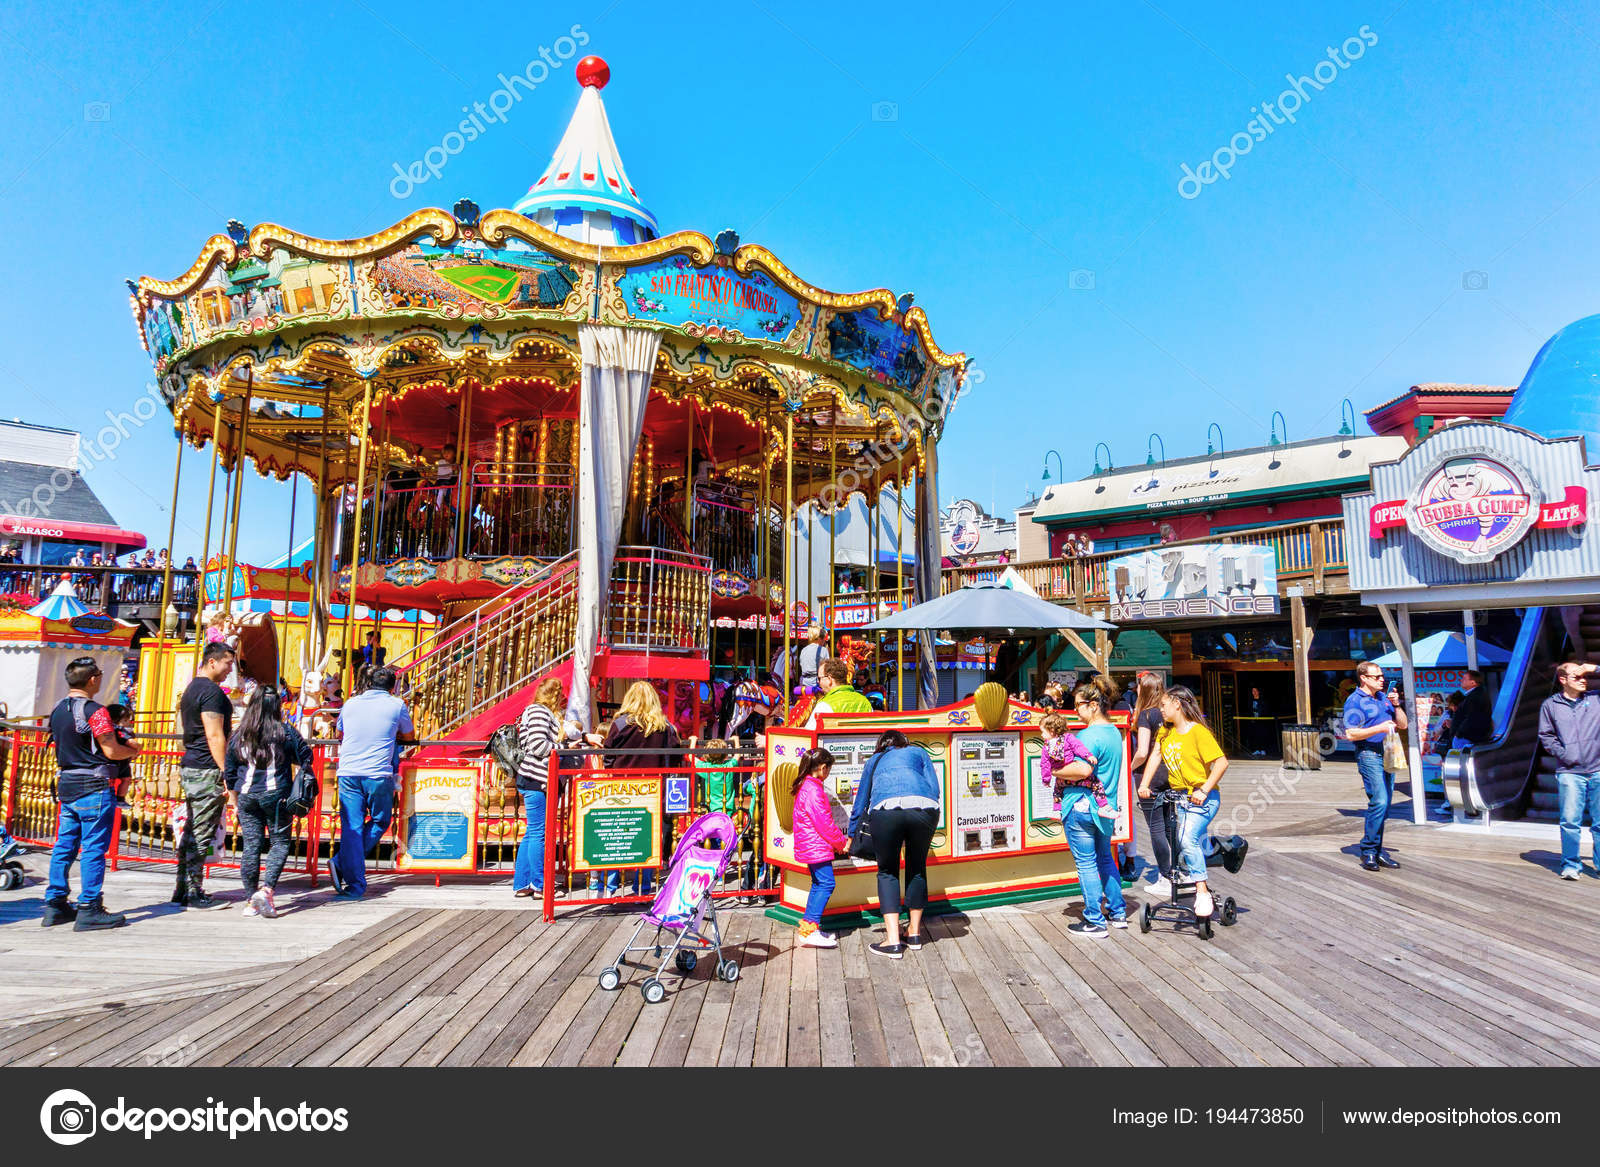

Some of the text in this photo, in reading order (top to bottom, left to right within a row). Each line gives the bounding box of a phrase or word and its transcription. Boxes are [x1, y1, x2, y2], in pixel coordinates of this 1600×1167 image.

[650, 274, 778, 315] SAN FRANCISCO CAROUSEL
[1171, 477, 1240, 493] pizzeria
[1166, 499, 1185, 507] PASTA
[1188, 496, 1205, 504] SOUP
[1374, 505, 1406, 524] OPEN
[1421, 497, 1527, 523] BUBBA GUMP
[1542, 504, 1580, 523] LATE
[1440, 518, 1478, 530] SHRIMP
[12, 525, 64, 537] TARASCO
[1110, 597, 1275, 621] EXPERIENCE
[884, 643, 913, 652] CHUOS
[965, 645, 993, 655] CHURRS
[1414, 671, 1465, 682] HOTOS
[829, 744, 877, 753] Currency Curre
[961, 741, 985, 749] Currency
[408, 776, 472, 795] ENTRANCE
[580, 782, 658, 808] ENTRANCE
[957, 813, 1015, 826] Carousel Tokens
